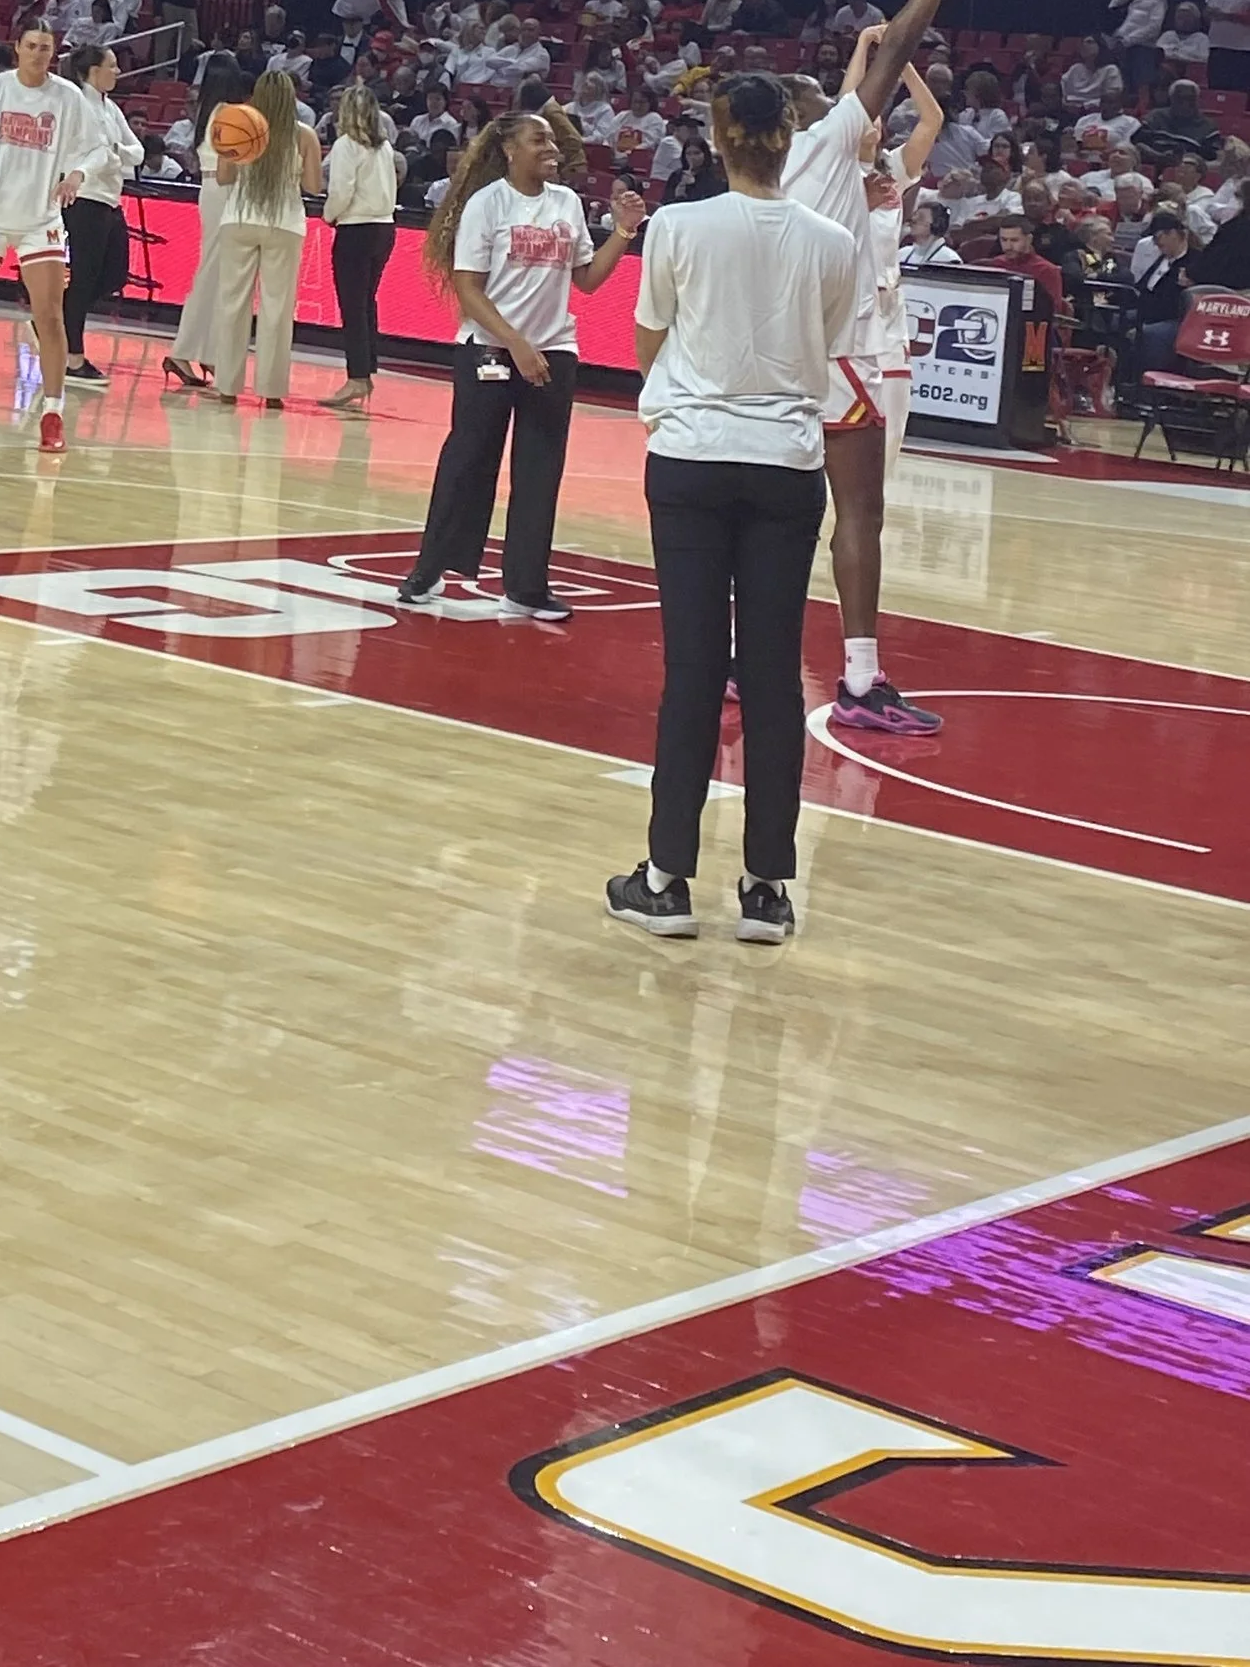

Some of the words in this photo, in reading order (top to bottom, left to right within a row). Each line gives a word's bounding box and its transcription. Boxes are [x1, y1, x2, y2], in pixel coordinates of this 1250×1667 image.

[47, 230, 59, 242] M
[1196, 301, 1250, 317] MARYLAND
[1022, 321, 1048, 371] M
